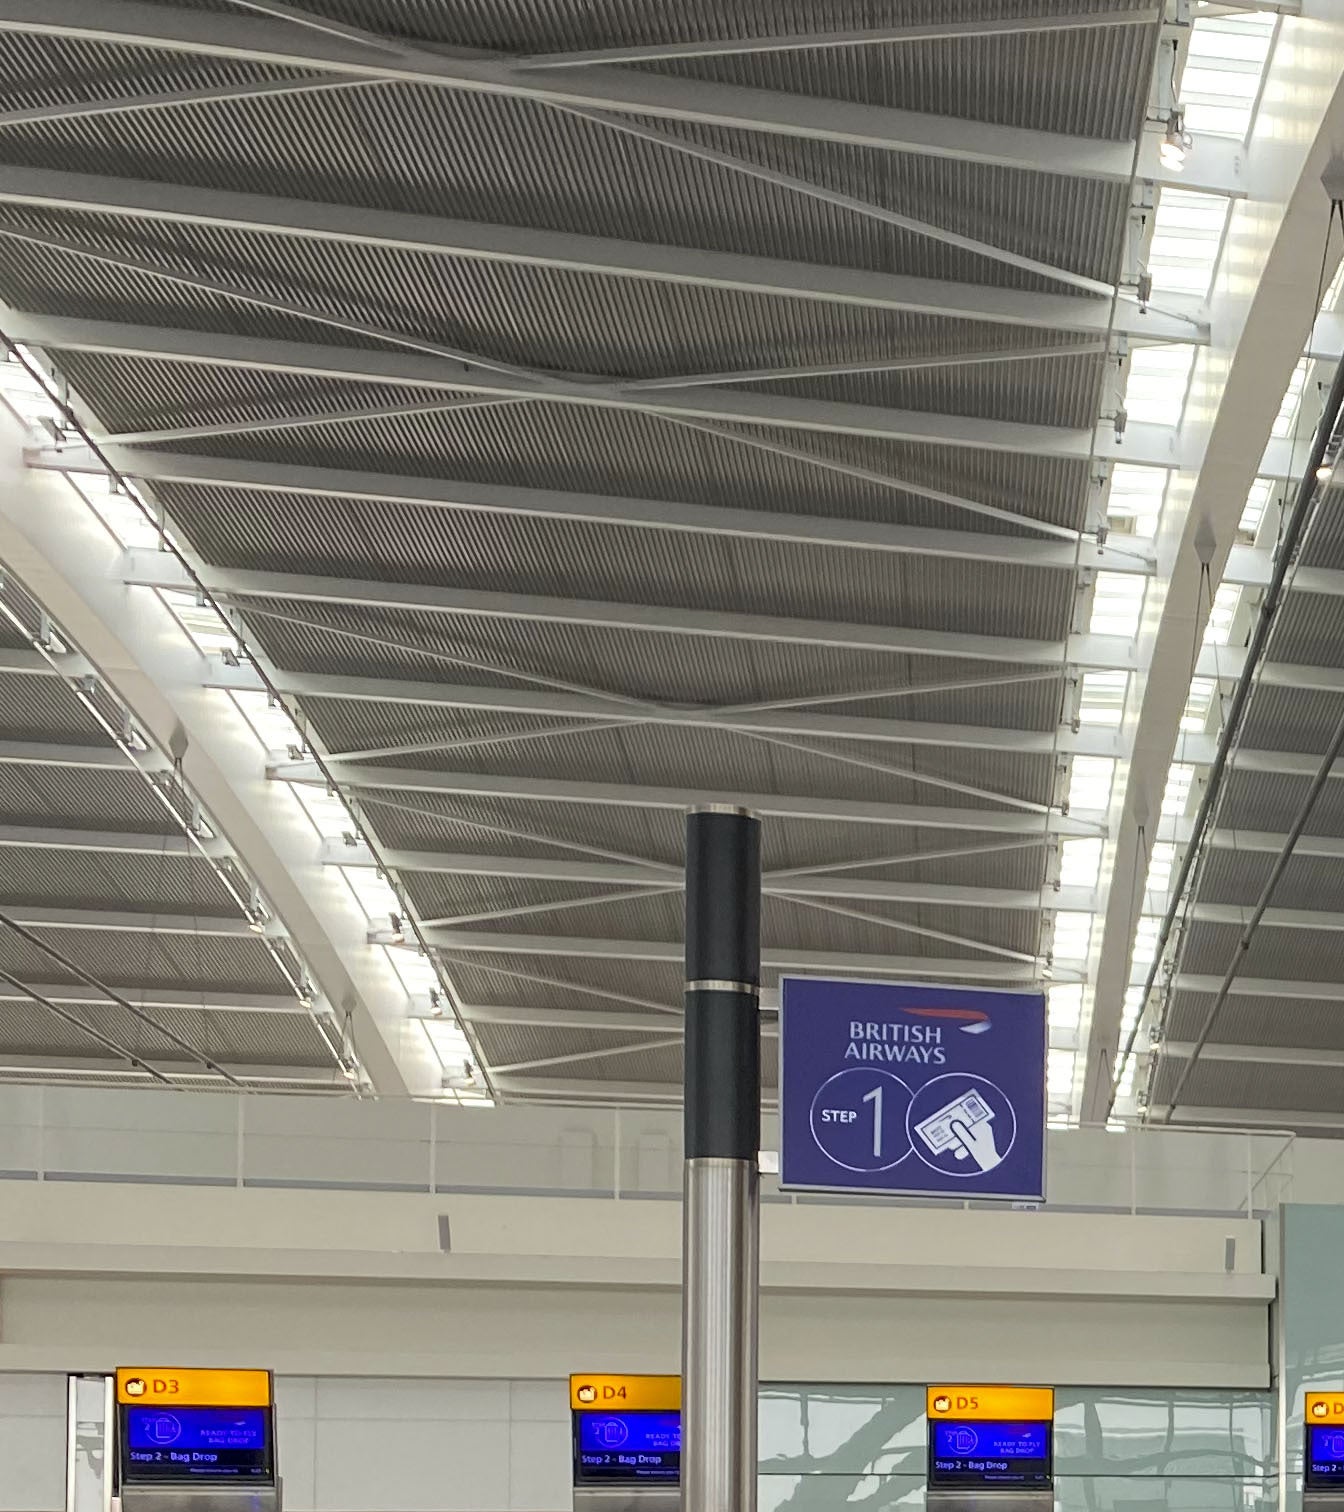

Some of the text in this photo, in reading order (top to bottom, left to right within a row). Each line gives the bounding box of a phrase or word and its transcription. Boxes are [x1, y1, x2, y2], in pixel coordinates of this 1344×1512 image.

[850, 1021, 942, 1044] BRITISH
[844, 1042, 946, 1064] AIRWAYS
[821, 1086, 883, 1157] STEP 1
[153, 1379, 179, 1394] D3
[603, 1385, 627, 1399] D4
[956, 1397, 979, 1409] D5
[130, 1452, 217, 1462] Step 2 Bag Drop
[582, 1455, 661, 1465] Step 2 Bag Drop
[936, 1461, 1008, 1471] Step 2 Bag Drop
[1312, 1464, 1330, 1472] Step
[1331, 1464, 1336, 1472] 2
